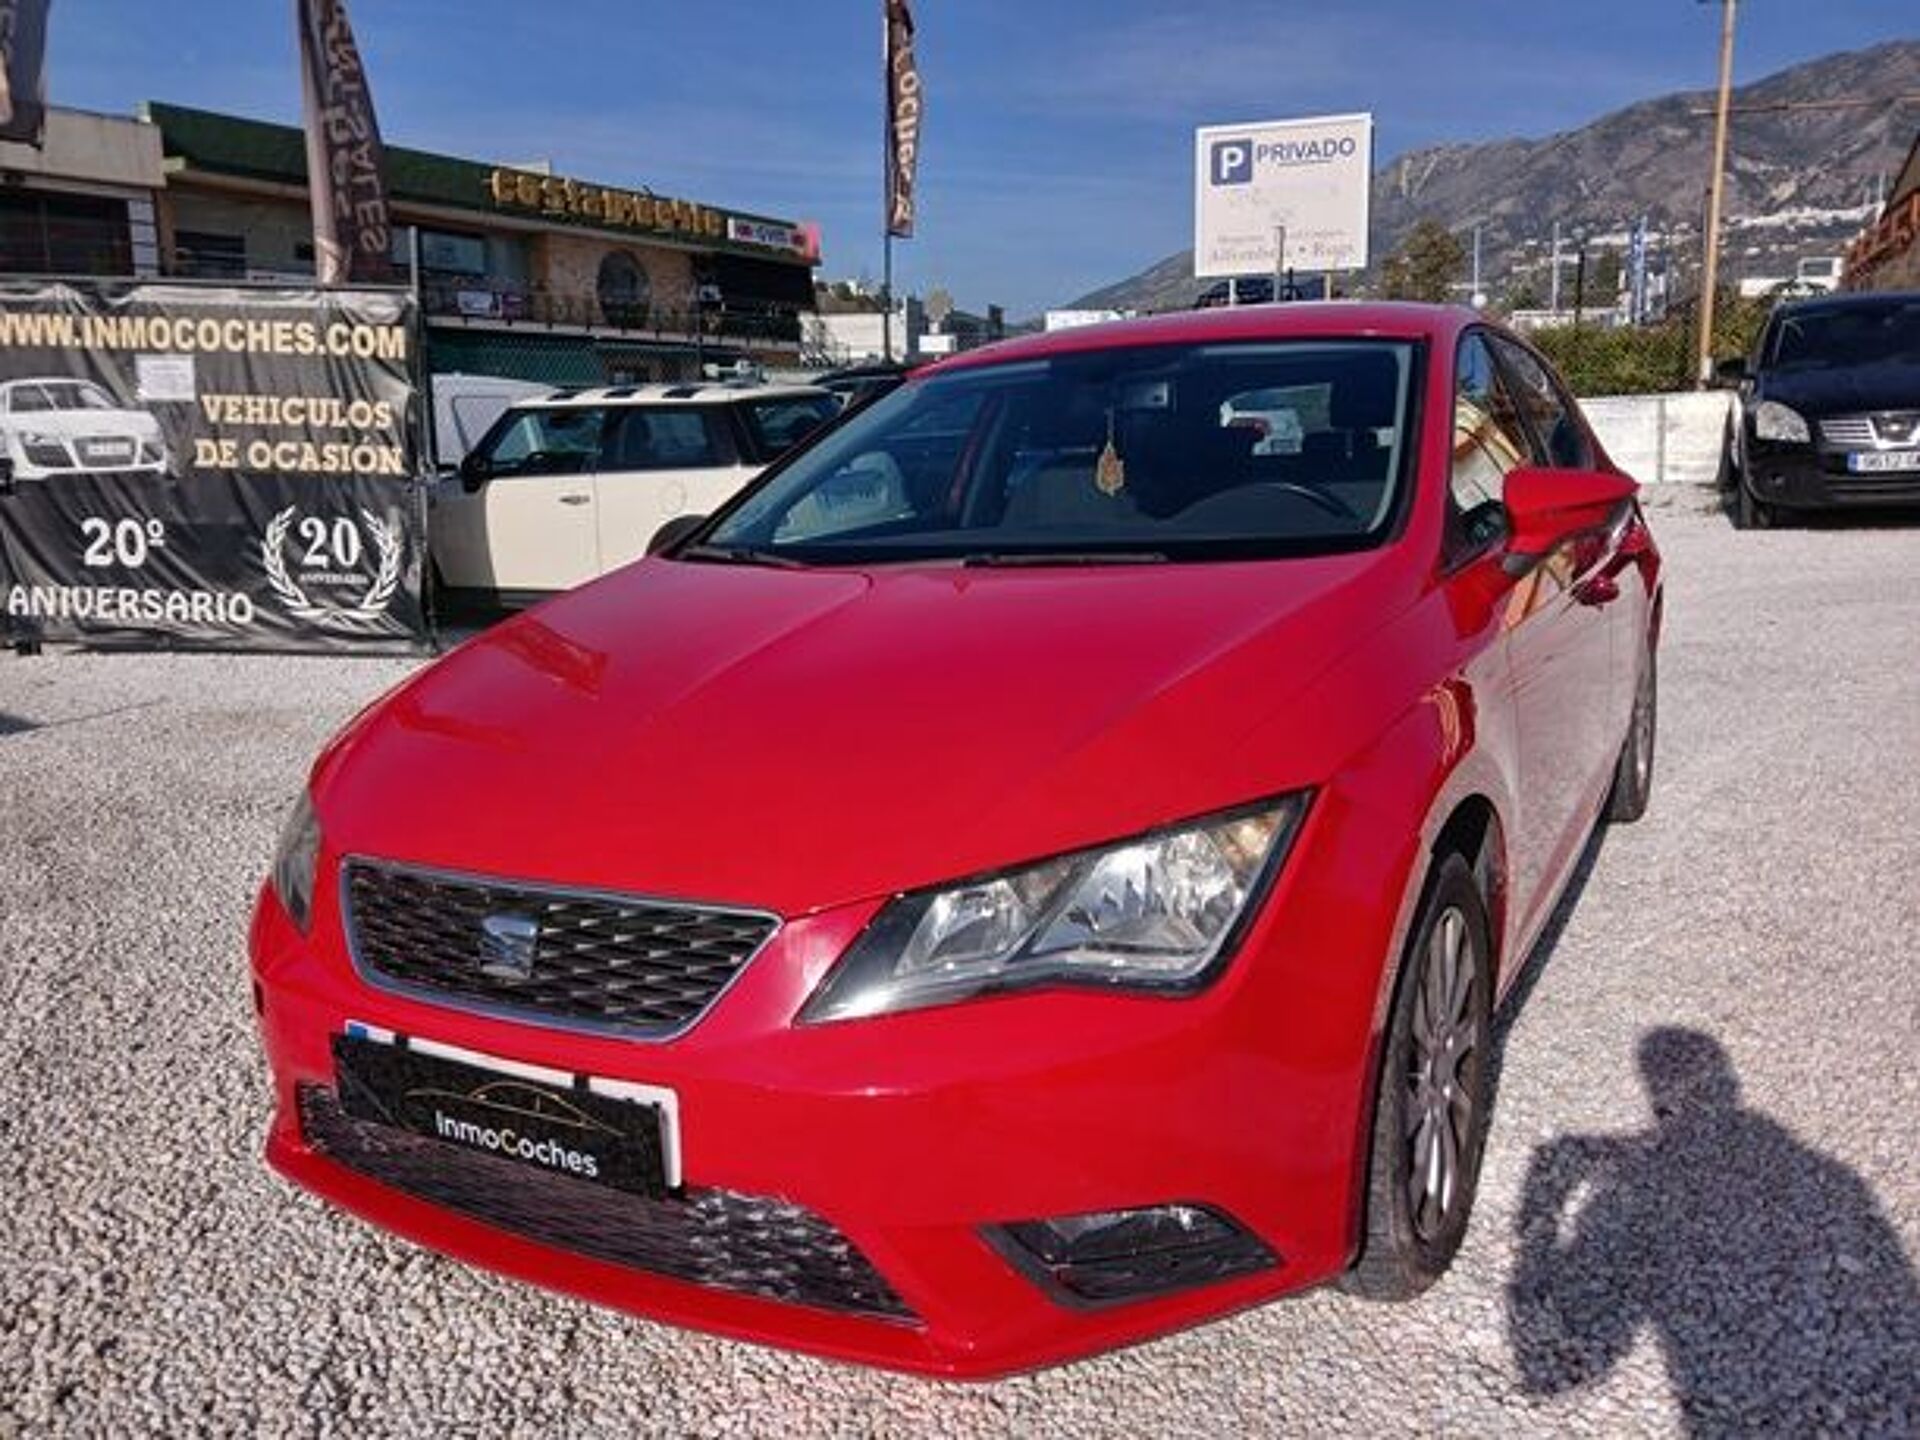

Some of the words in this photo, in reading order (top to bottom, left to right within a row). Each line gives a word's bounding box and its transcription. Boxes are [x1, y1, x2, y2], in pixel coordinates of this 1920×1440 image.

[1220, 146, 1244, 180] P
[1256, 136, 1357, 163] PRIVADO
[201, 394, 393, 428] VEHICULOS
[194, 438, 239, 469] DE
[247, 435, 404, 474] OCASIÓN
[300, 517, 363, 569] 20
[7, 585, 254, 624] ANIVERSARIO
[434, 1109, 599, 1178] InmoCoches
